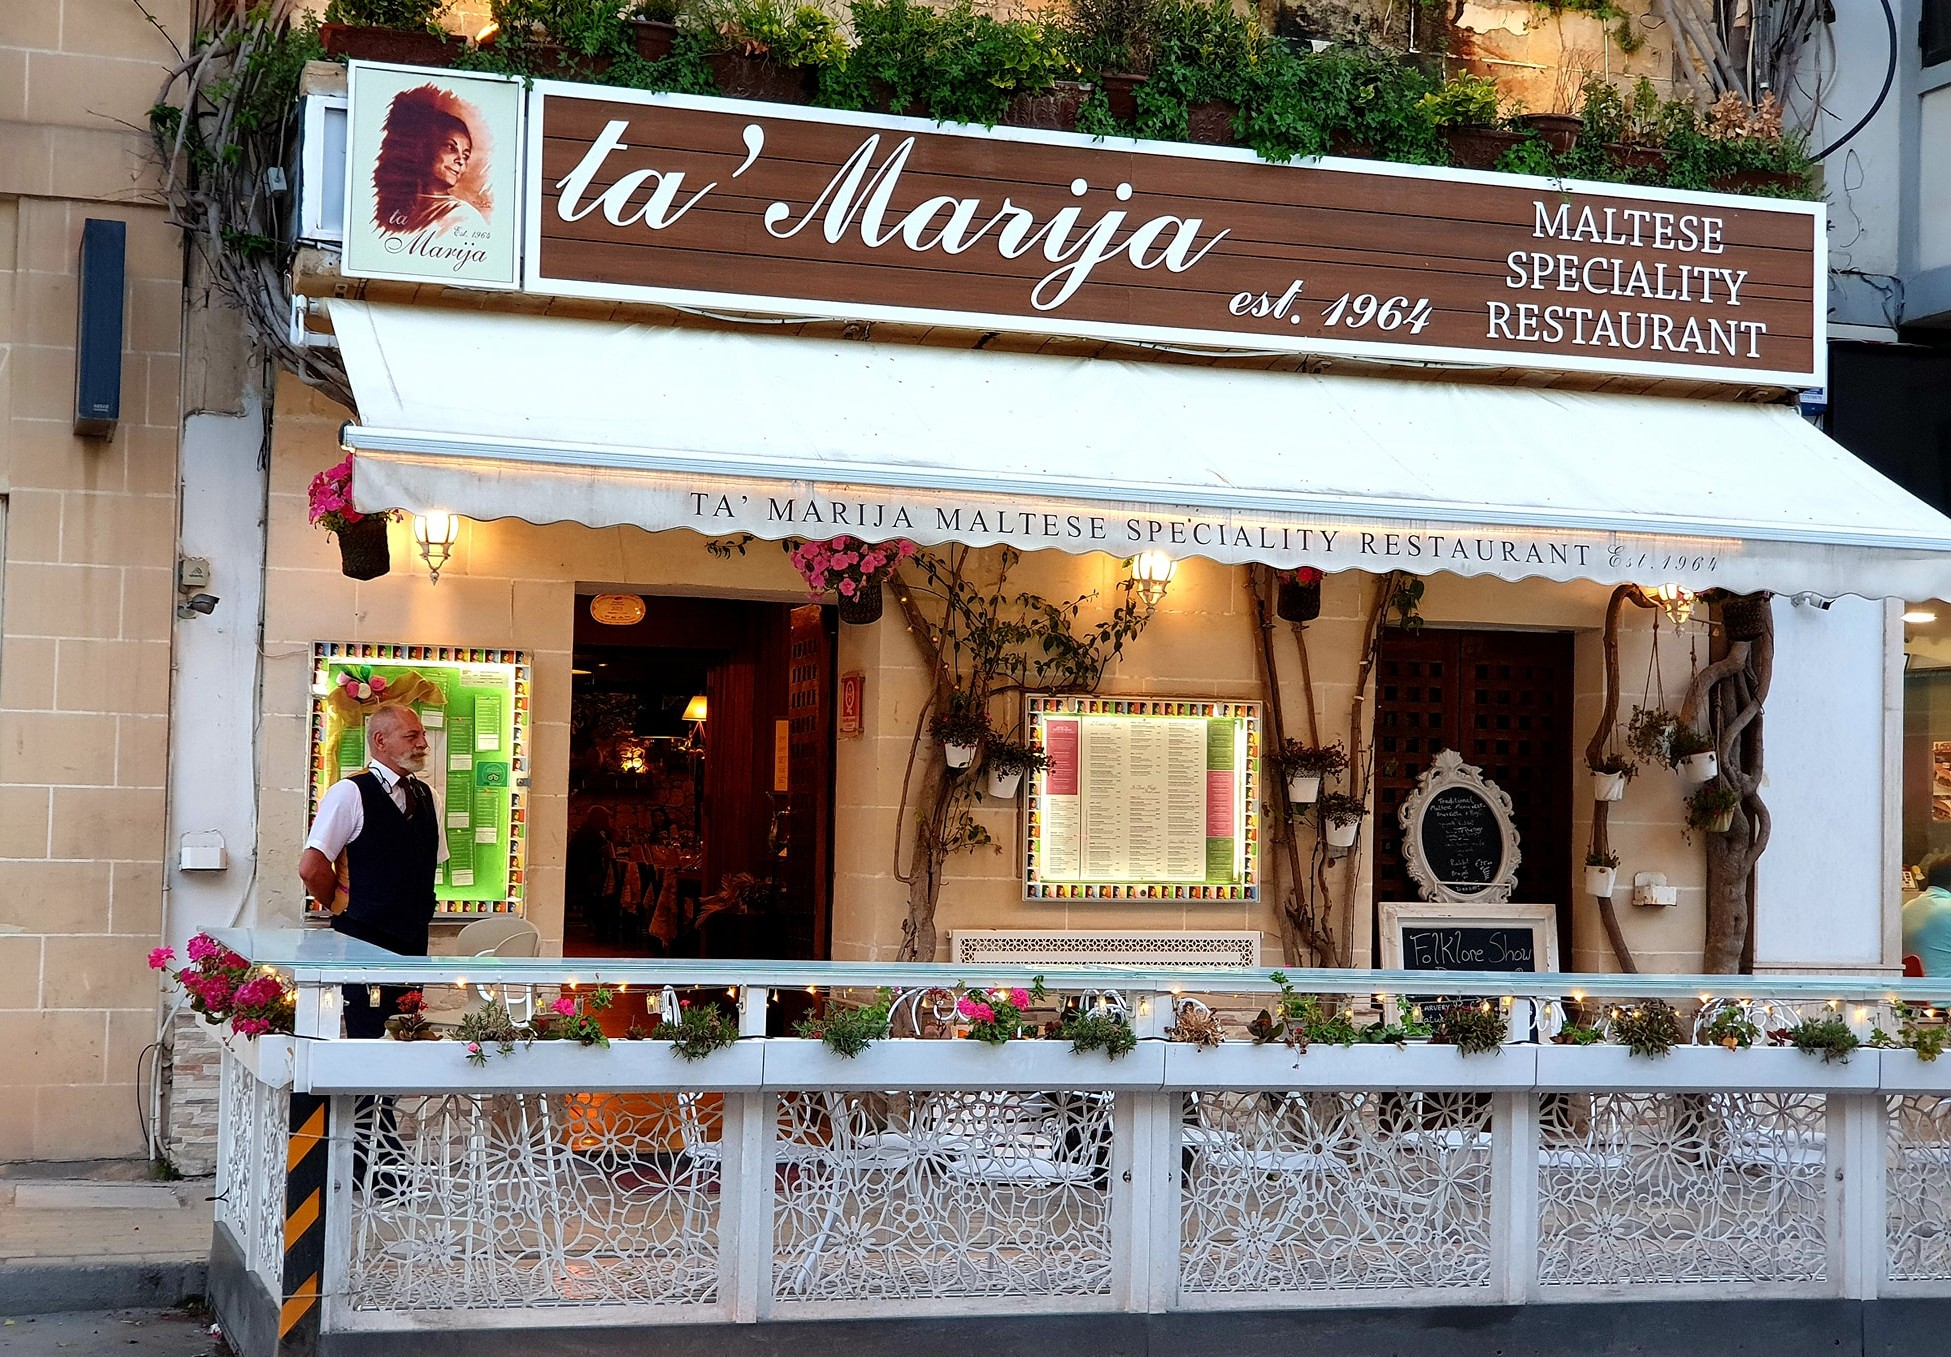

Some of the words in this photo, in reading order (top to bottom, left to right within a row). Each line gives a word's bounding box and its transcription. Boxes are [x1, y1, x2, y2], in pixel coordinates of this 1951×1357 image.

[389, 208, 409, 226] ta
[764, 134, 1231, 311] Marija
[1532, 200, 1725, 255] MALTESE
[384, 229, 488, 272] Marija
[1505, 250, 1748, 306] SPECIALITY
[1228, 278, 1304, 326] est.
[1320, 291, 1433, 336] 1964
[1486, 301, 1768, 359] RESTAURANT
[767, 497, 915, 530] MARIJA
[935, 506, 1107, 540] MALTESE
[1126, 518, 1339, 553] SPECIALITY
[1360, 532, 1591, 567] RESTAURANT
[1489, 932, 1532, 963] Show
